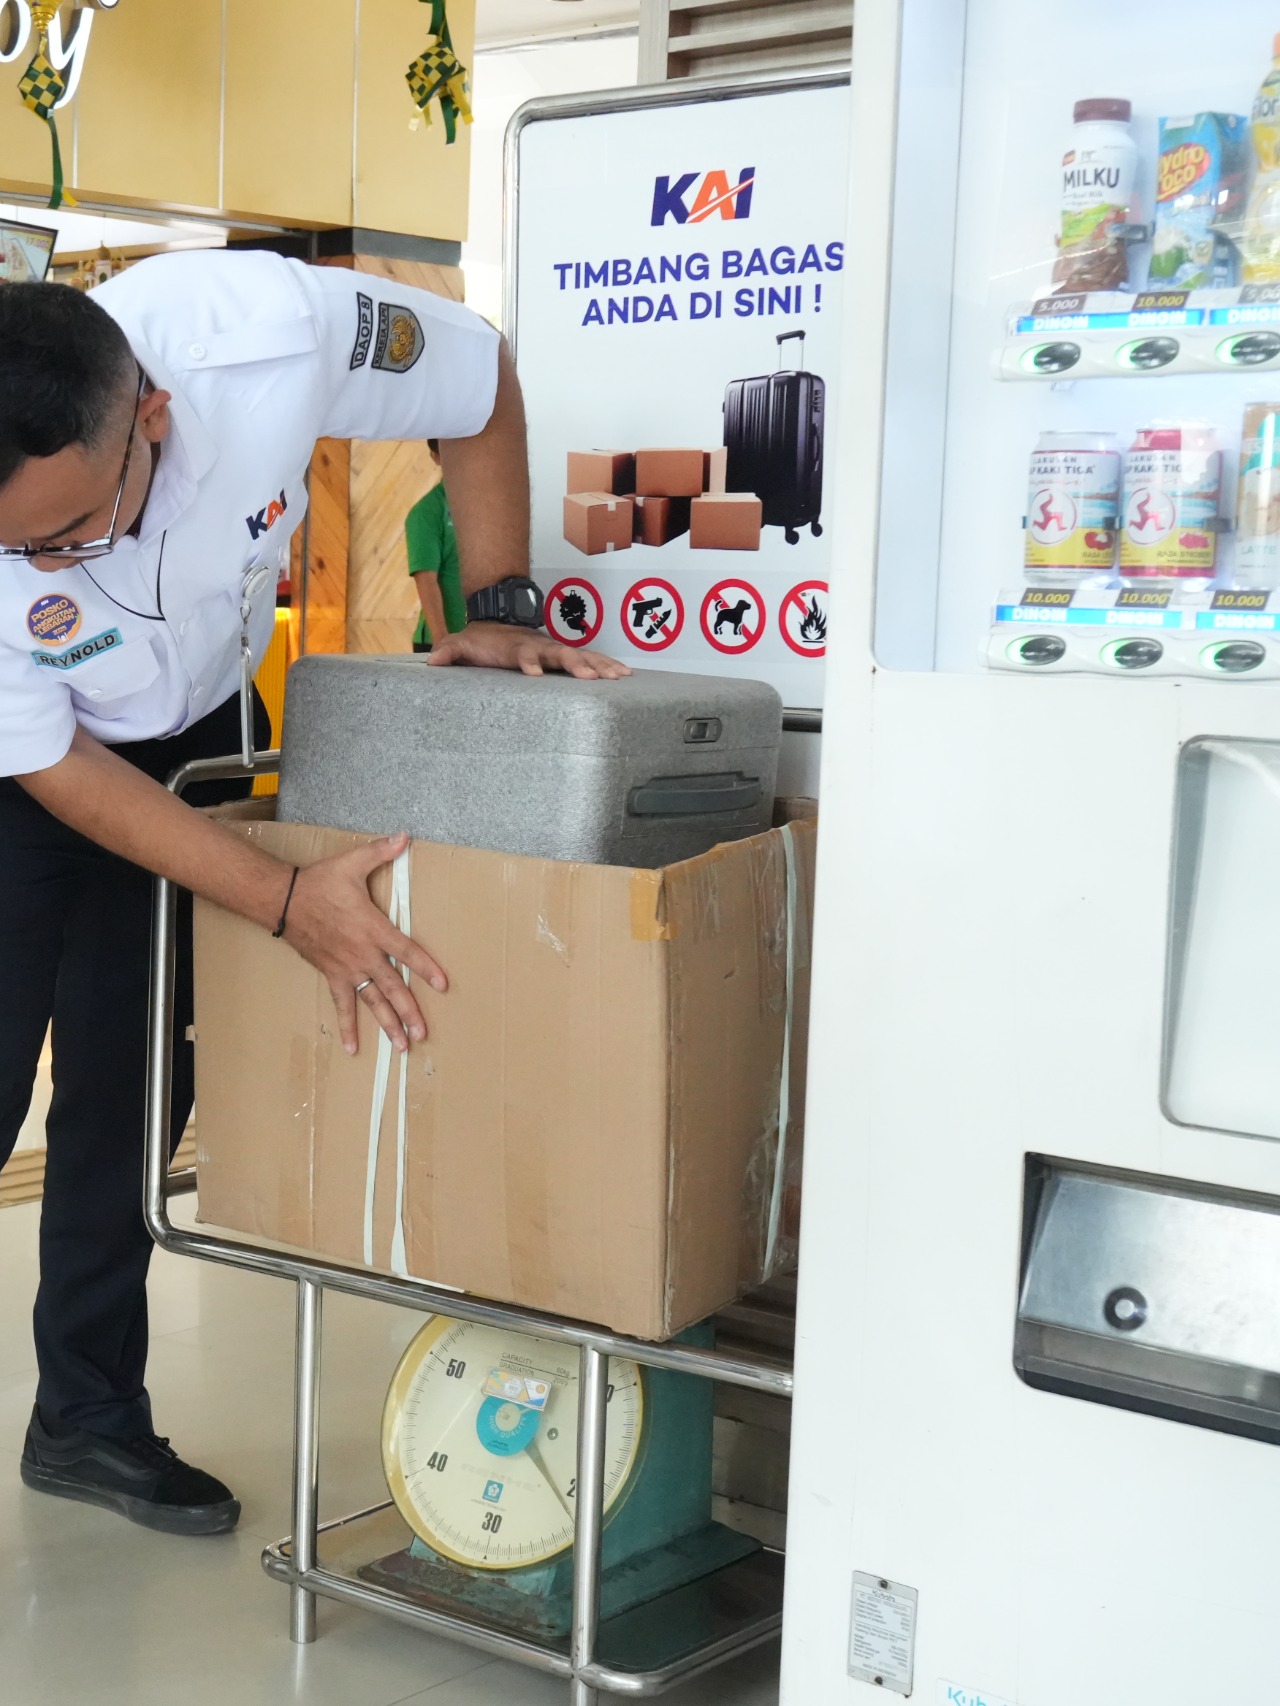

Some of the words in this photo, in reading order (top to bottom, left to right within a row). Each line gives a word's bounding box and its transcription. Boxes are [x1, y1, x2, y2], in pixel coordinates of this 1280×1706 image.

[1063, 167, 1120, 193] MILKU
[1159, 165, 1197, 192] oco
[650, 166, 756, 227] KAI
[553, 251, 710, 291] TIMBANG
[361, 301, 370, 310] 8
[581, 293, 678, 327] ANDA
[690, 289, 722, 320] DI
[733, 285, 802, 318] SINI
[813, 283, 823, 313] !
[1136, 295, 1185, 308] 10.000
[354, 313, 371, 362] DAOP
[245, 488, 288, 541] KAI
[1025, 592, 1070, 605] 10.000
[1120, 592, 1168, 605] 10.000
[1215, 594, 1265, 607] 10.000
[31, 599, 69, 623] POSKO
[33, 606, 76, 633] ANGKUTAN
[39, 613, 75, 635] LEBARAN
[40, 634, 115, 667] REYNOLD
[445, 1358, 465, 1380] 50
[501, 1352, 533, 1366] CAPACITY
[427, 1450, 448, 1473] 40
[481, 1511, 503, 1534] 30
